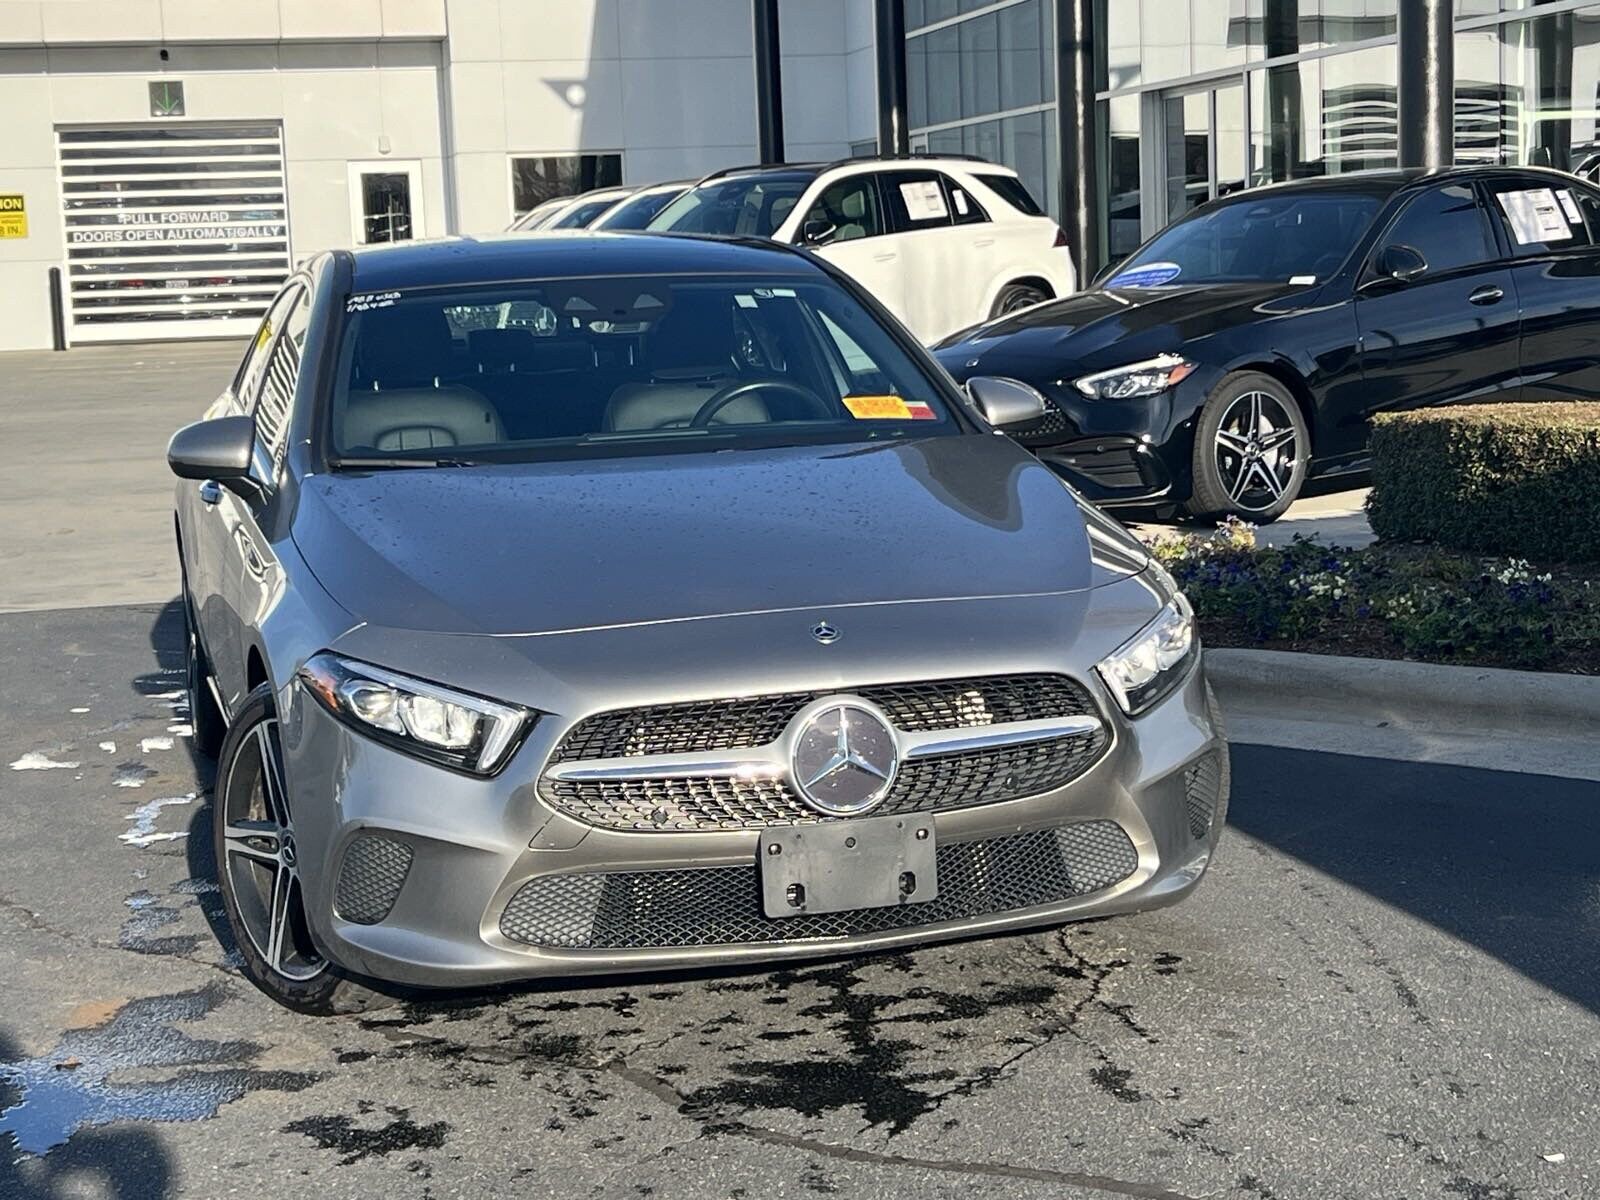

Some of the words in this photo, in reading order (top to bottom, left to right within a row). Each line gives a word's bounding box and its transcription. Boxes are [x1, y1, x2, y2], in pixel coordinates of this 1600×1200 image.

[123, 213, 159, 225] PULL
[160, 211, 230, 224] FORWARD
[73, 230, 123, 243] DOORS
[125, 229, 164, 241] OPEN
[167, 226, 281, 240] AUTOMATICALLY
